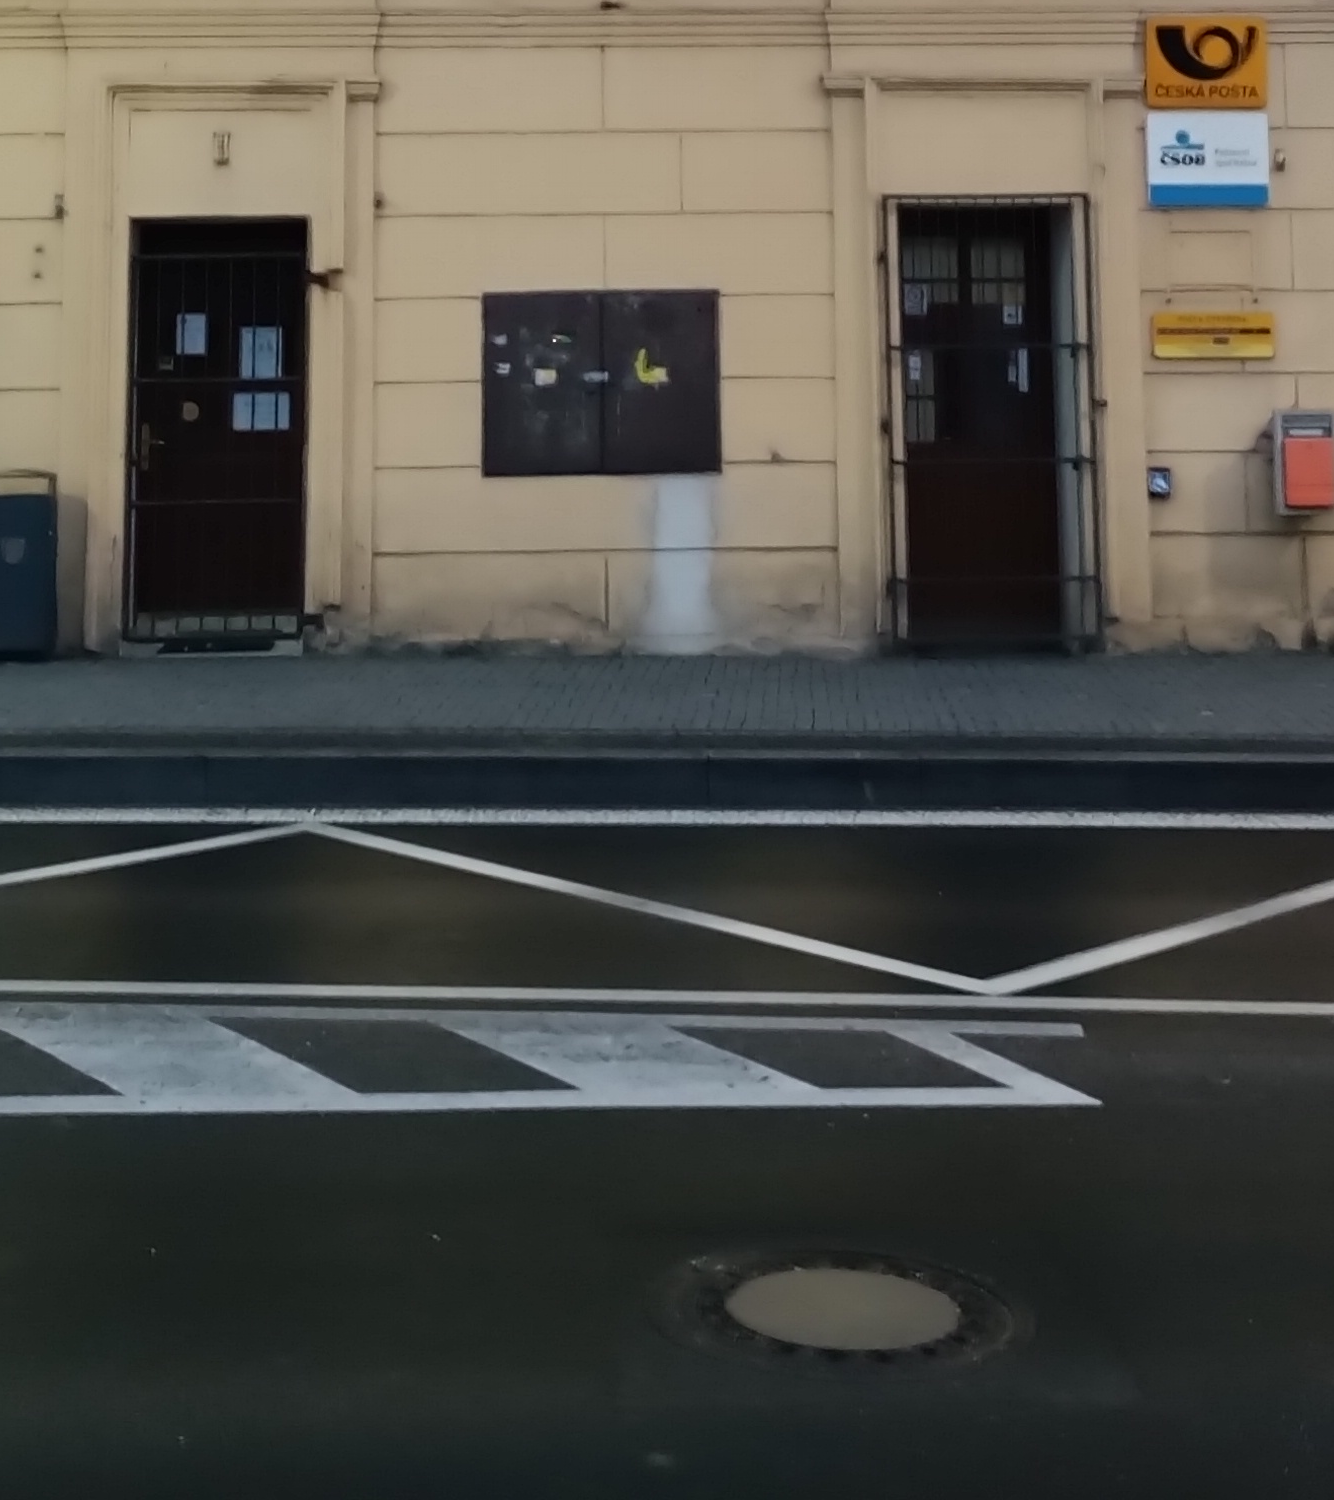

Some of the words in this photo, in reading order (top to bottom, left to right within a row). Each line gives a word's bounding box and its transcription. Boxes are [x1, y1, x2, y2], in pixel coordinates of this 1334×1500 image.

[1155, 82, 1205, 98] ČESKÁ
[1209, 84, 1260, 98] POŠTA
[1160, 151, 1206, 166] ČSOB
